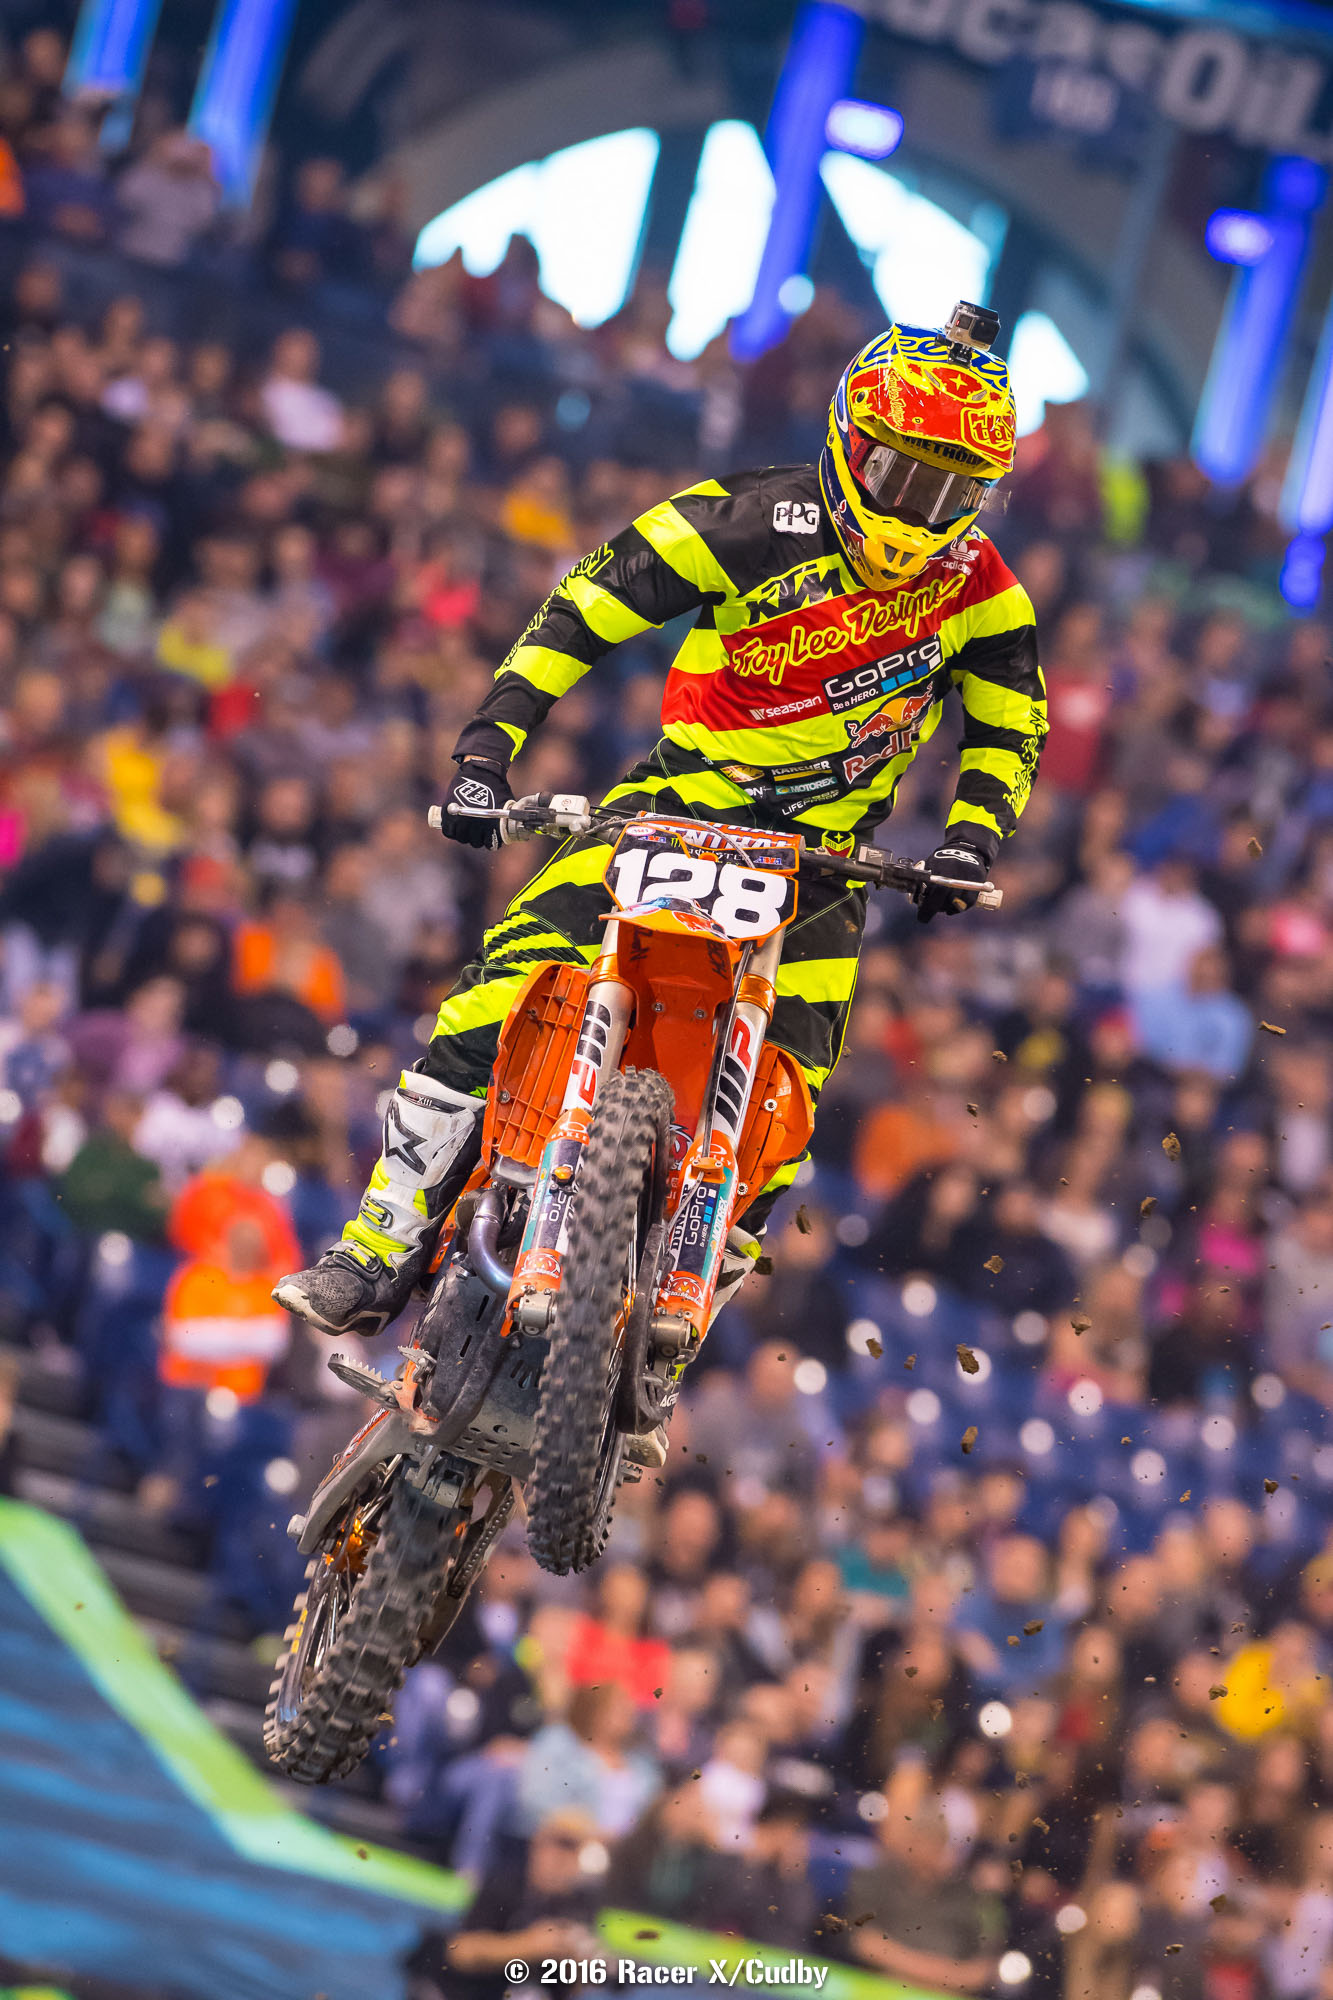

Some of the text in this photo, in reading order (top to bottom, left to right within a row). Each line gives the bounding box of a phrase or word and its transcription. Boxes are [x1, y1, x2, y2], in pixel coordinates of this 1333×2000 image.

[775, 502, 817, 526] PPG
[745, 562, 847, 626] KTM
[732, 573, 967, 686] Troy Lee Designs
[824, 639, 941, 698] GoPro
[766, 695, 823, 719] seaspan
[832, 701, 844, 712] Be
[844, 700, 850, 708] a
[790, 776, 835, 794] MOTOREX
[613, 848, 788, 938] 128
[684, 1186, 707, 1246] GoPro
